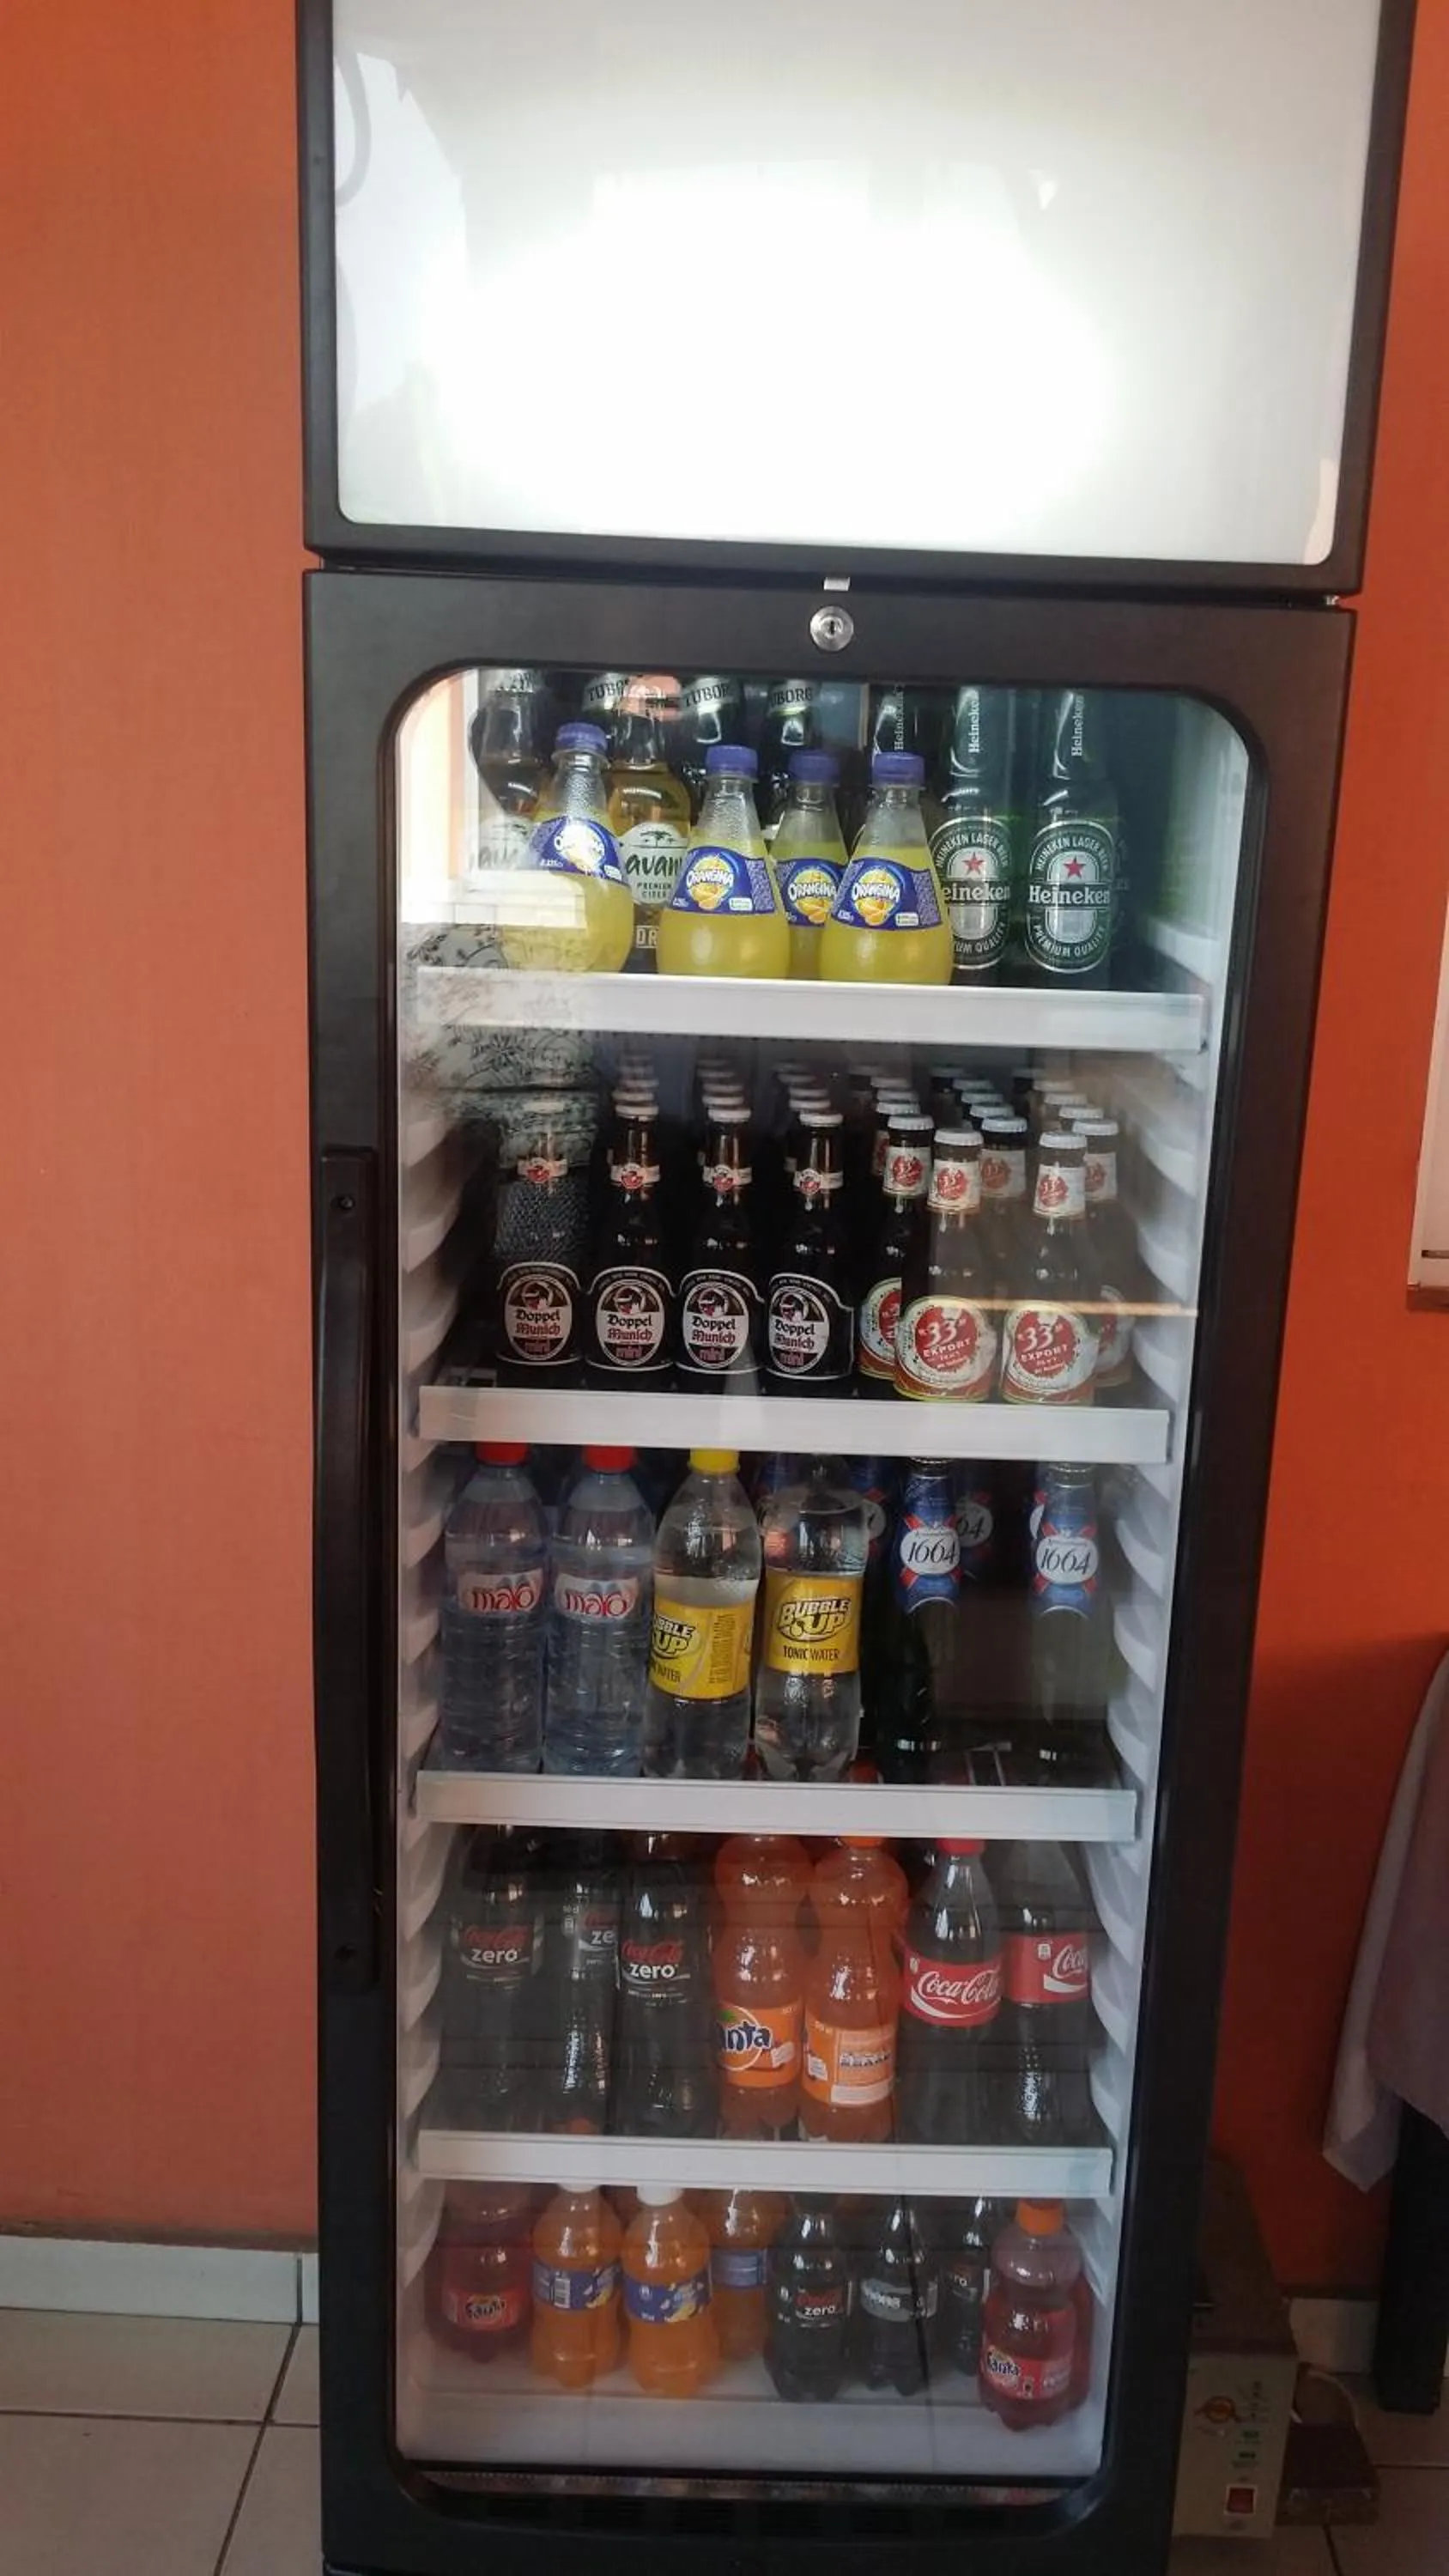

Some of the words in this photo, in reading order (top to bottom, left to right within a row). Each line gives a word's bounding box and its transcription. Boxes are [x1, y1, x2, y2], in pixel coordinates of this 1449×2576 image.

[589, 677, 628, 702] TUBO
[686, 683, 729, 707] TUBOR
[772, 687, 814, 706] BORG
[967, 697, 980, 754] Heineke
[943, 882, 1011, 902] eineken
[1029, 884, 1111, 905] Heineken
[636, 927, 658, 945] DR
[515, 1309, 561, 1323] Doppel
[607, 1313, 653, 1327] Doppel
[691, 1315, 736, 1331] Doppel
[516, 1322, 561, 1336] Munich
[608, 1327, 653, 1342] Munich
[692, 1330, 736, 1345] Munich
[774, 1319, 815, 1337] Doppel
[775, 1333, 815, 1350] Munich
[923, 1338, 972, 1358] EXPORT
[1021, 1343, 1069, 1364] EXPORT
[957, 1514, 985, 1540] 64
[906, 1538, 956, 1564] 1664
[1039, 1546, 1092, 1576] 1664
[779, 1597, 853, 1628] BUBBLE
[655, 1614, 696, 1638] BBLE
[797, 1613, 846, 1636] UP
[654, 1631, 689, 1656] UP
[783, 1644, 808, 1662] TONIC
[809, 1648, 840, 1662] WATER
[591, 1929, 617, 1946] ze
[471, 1947, 518, 1965] zero
[629, 1962, 676, 1979] zero
[918, 1967, 1000, 2005] Coca-Cola
[718, 2018, 773, 2055] nta
[804, 2305, 835, 2316] zero
